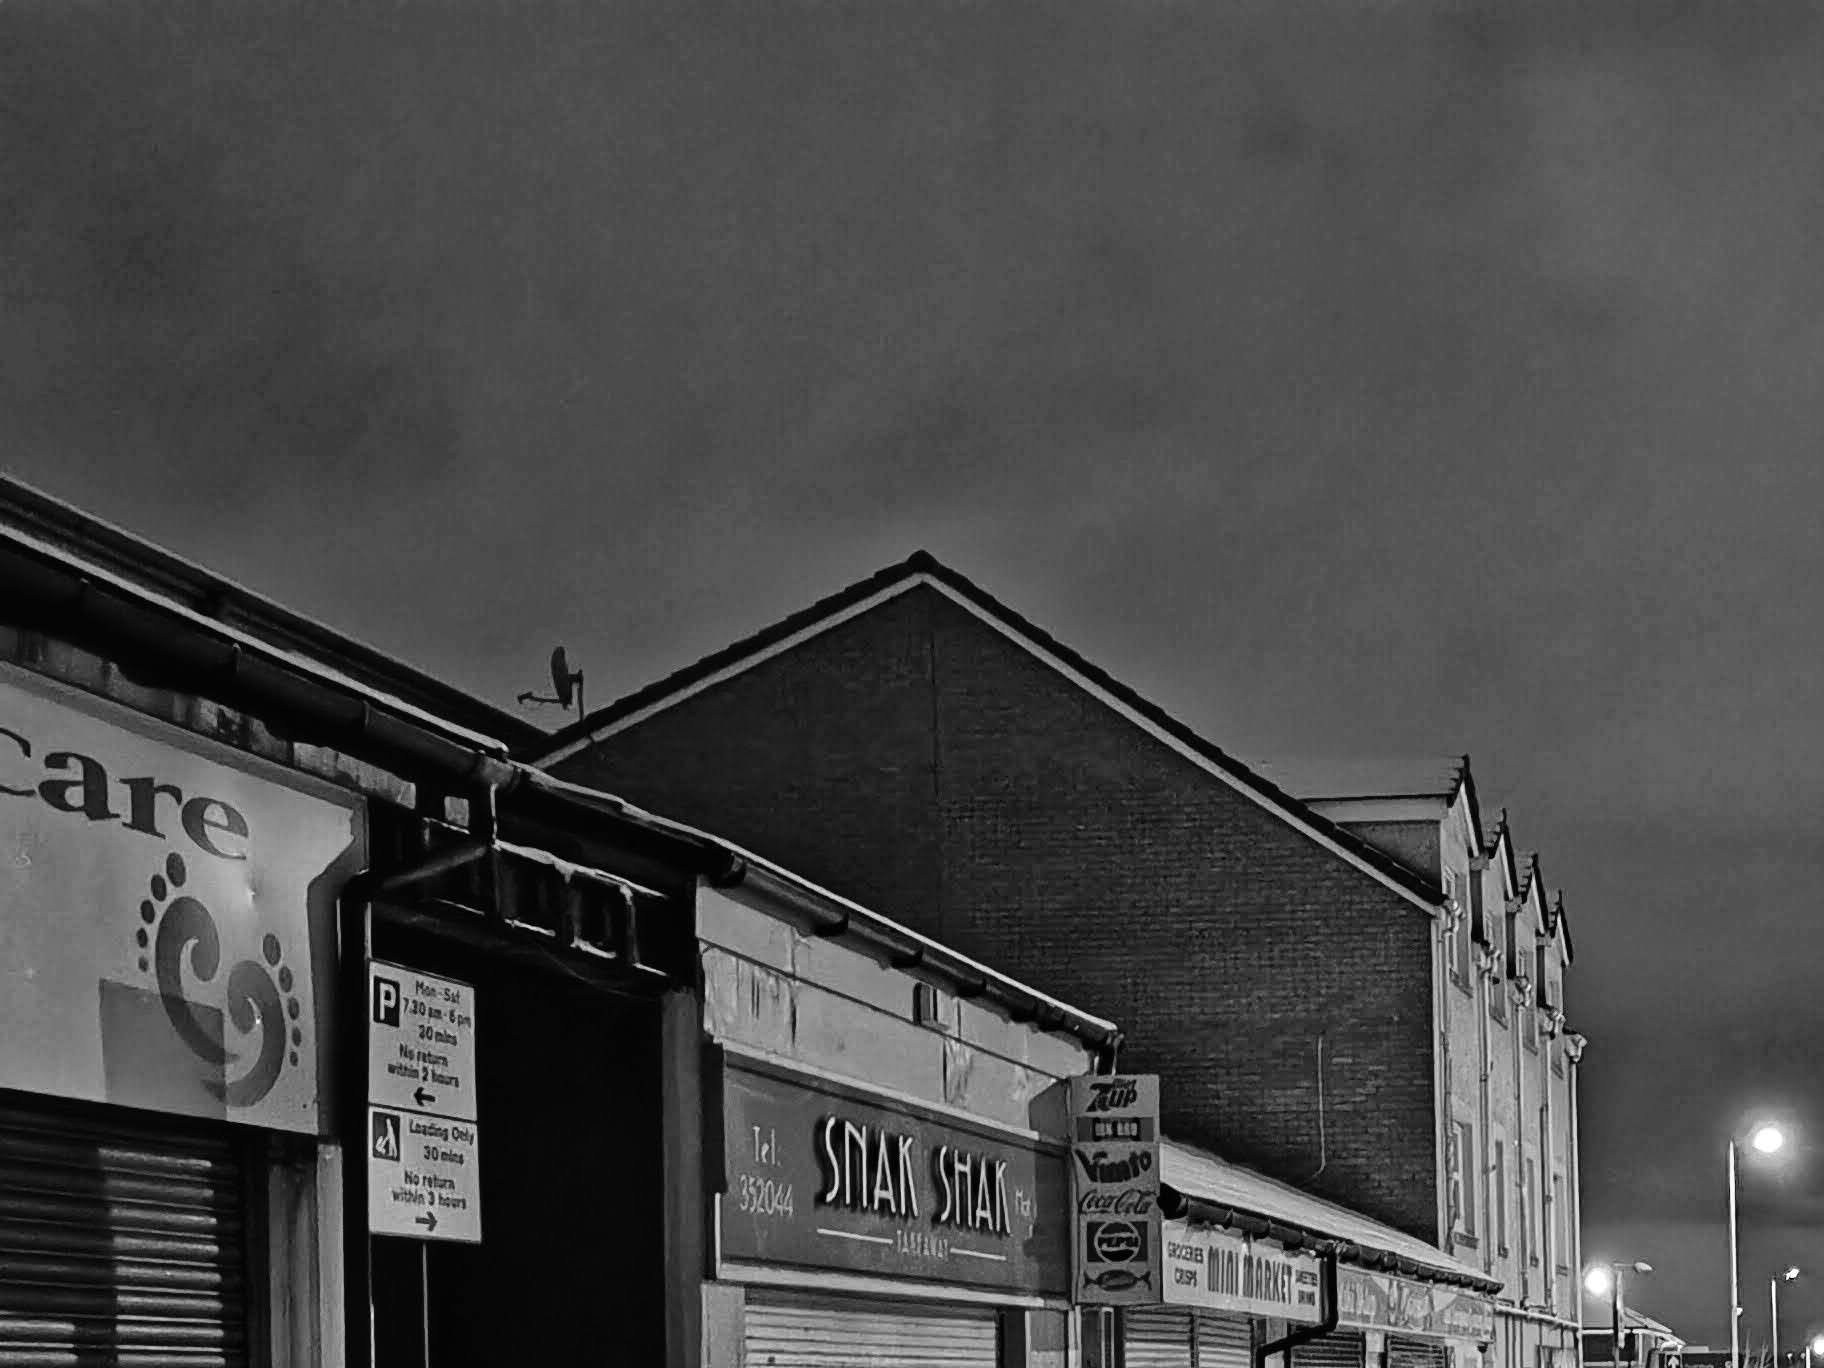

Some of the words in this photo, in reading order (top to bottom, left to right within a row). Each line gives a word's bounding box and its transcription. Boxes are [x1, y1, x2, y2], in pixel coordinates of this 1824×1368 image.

[380, 982, 397, 1021] P
[418, 1024, 434, 1041] 30
[435, 1030, 458, 1046] mins
[399, 1042, 415, 1061] No
[416, 1050, 449, 1068] return
[387, 1062, 420, 1079] within
[431, 1069, 460, 1088] hours
[409, 1119, 449, 1141] Loading
[451, 1126, 475, 1146] Only
[423, 1145, 439, 1160] 30
[440, 1150, 465, 1166] mins
[404, 1170, 420, 1187] No
[422, 1174, 456, 1190] return
[824, 1114, 919, 1218] SNAK
[939, 1144, 1011, 1234] SHAK
[391, 1188, 425, 1206] within
[427, 1190, 436, 1206] 3
[438, 1193, 467, 1211] hours
[740, 1173, 794, 1217] 352044
[1207, 1245, 1239, 1297] MINI
[1242, 1253, 1293, 1305] MARKET
